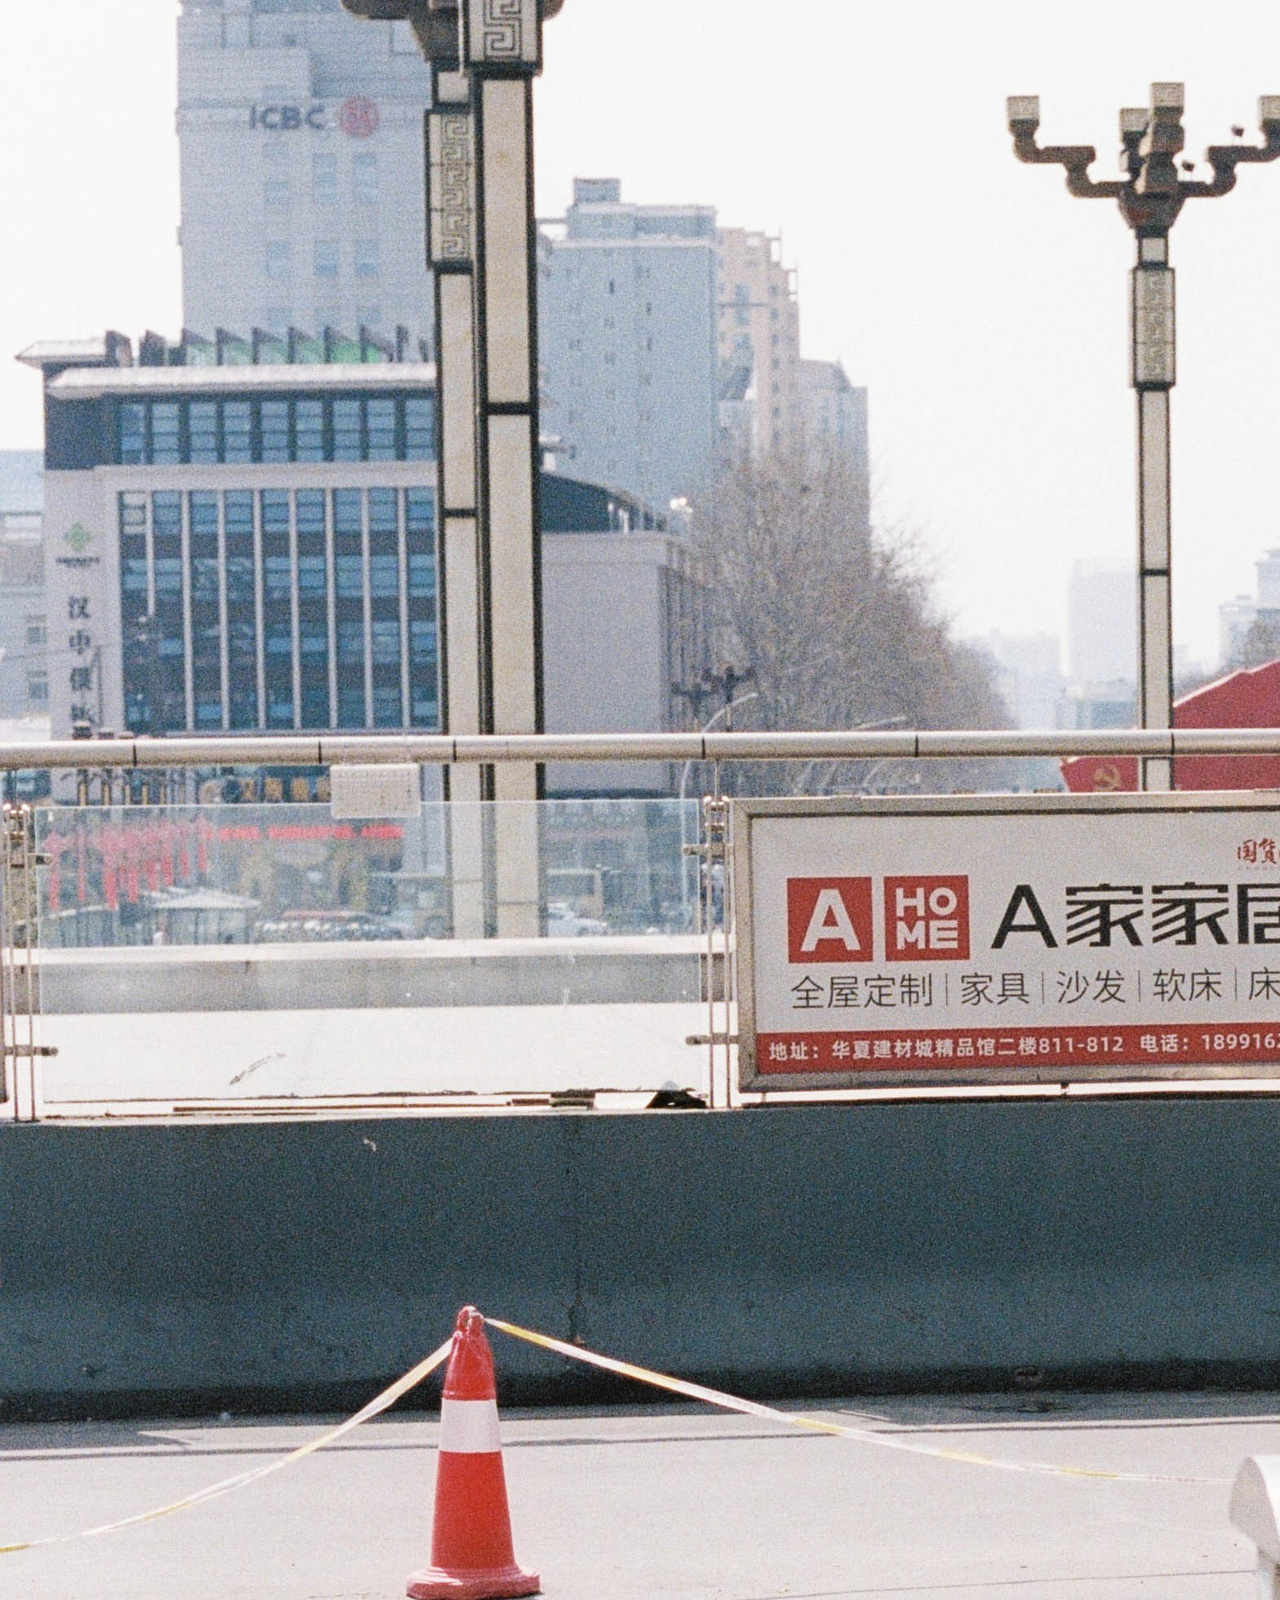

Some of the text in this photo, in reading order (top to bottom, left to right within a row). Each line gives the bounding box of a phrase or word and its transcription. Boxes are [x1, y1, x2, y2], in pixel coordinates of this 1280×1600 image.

[250, 105, 326, 130] ICBC
[800, 887, 862, 953] A
[790, 972, 934, 1010] 全屋定制
[959, 970, 1030, 1007] 家具
[1056, 968, 1126, 1005] 沙发
[1152, 966, 1223, 1002] 软床
